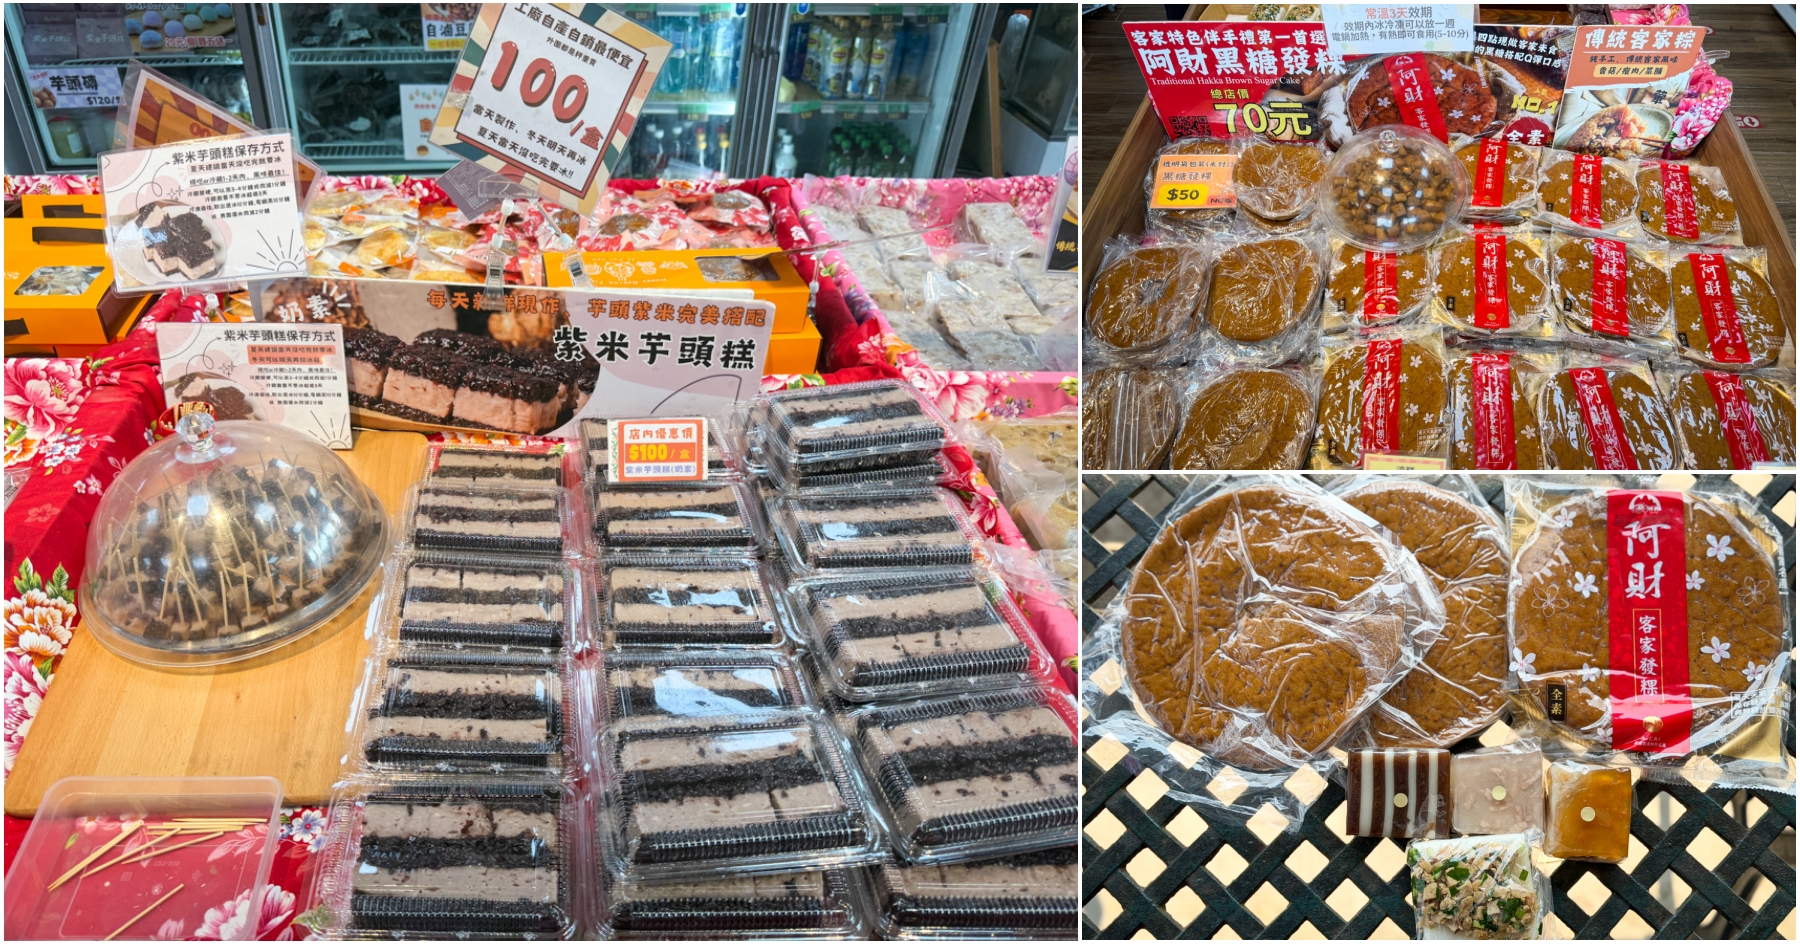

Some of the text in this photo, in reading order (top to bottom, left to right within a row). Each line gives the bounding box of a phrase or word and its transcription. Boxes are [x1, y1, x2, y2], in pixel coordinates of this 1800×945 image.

[1365, 6, 1432, 20] 常溫3天效期
[426, 23, 471, 38] 自滷豆
[514, 3, 634, 70] 工廠自產自銷最便宜
[1344, 19, 1455, 32] 效期內冰冷凍可以放一週
[1130, 28, 1327, 46] 客家特色伴手禮第一首選
[1474, 31, 1558, 56] 四點現做客家米食
[1584, 28, 1697, 50] 傳統客家粽
[1138, 48, 1348, 76] 阿財黑糖發粿
[50, 75, 98, 91] 芋頭磚
[1150, 76, 1300, 86] Traditional Hakka Brown Sugar Cake
[1396, 68, 1424, 104] 阿財
[1210, 88, 1250, 100] 總店價
[1511, 94, 1558, 115] NO.1
[1214, 101, 1312, 136] 70元
[1414, 108, 1432, 134] 客家發
[1506, 130, 1544, 145] 全素
[172, 140, 285, 166] 紫米芋頭糕保存方式
[1484, 144, 1502, 164] 阿財
[1162, 172, 1212, 180] 黑糖發粿
[1579, 162, 1596, 184] 阿財
[1166, 188, 1200, 201] $50
[1056, 240, 1078, 252] 傳統
[1482, 242, 1500, 269] 阿財
[1700, 264, 1722, 296] 阿財
[279, 293, 332, 324] 奶素
[224, 330, 336, 342] 紫米芋頭糕保存方式
[552, 325, 757, 370] 紫米芋頭糕
[1372, 354, 1395, 389] 阿財
[1482, 366, 1502, 404] 阿財
[628, 427, 693, 440] 店內優惠價
[626, 464, 696, 474] 紫米芋頭糕(奶素)
[1623, 521, 1671, 599] 阿財
[1638, 615, 1658, 697] 客家發粿
[1550, 688, 1563, 716] 全素
